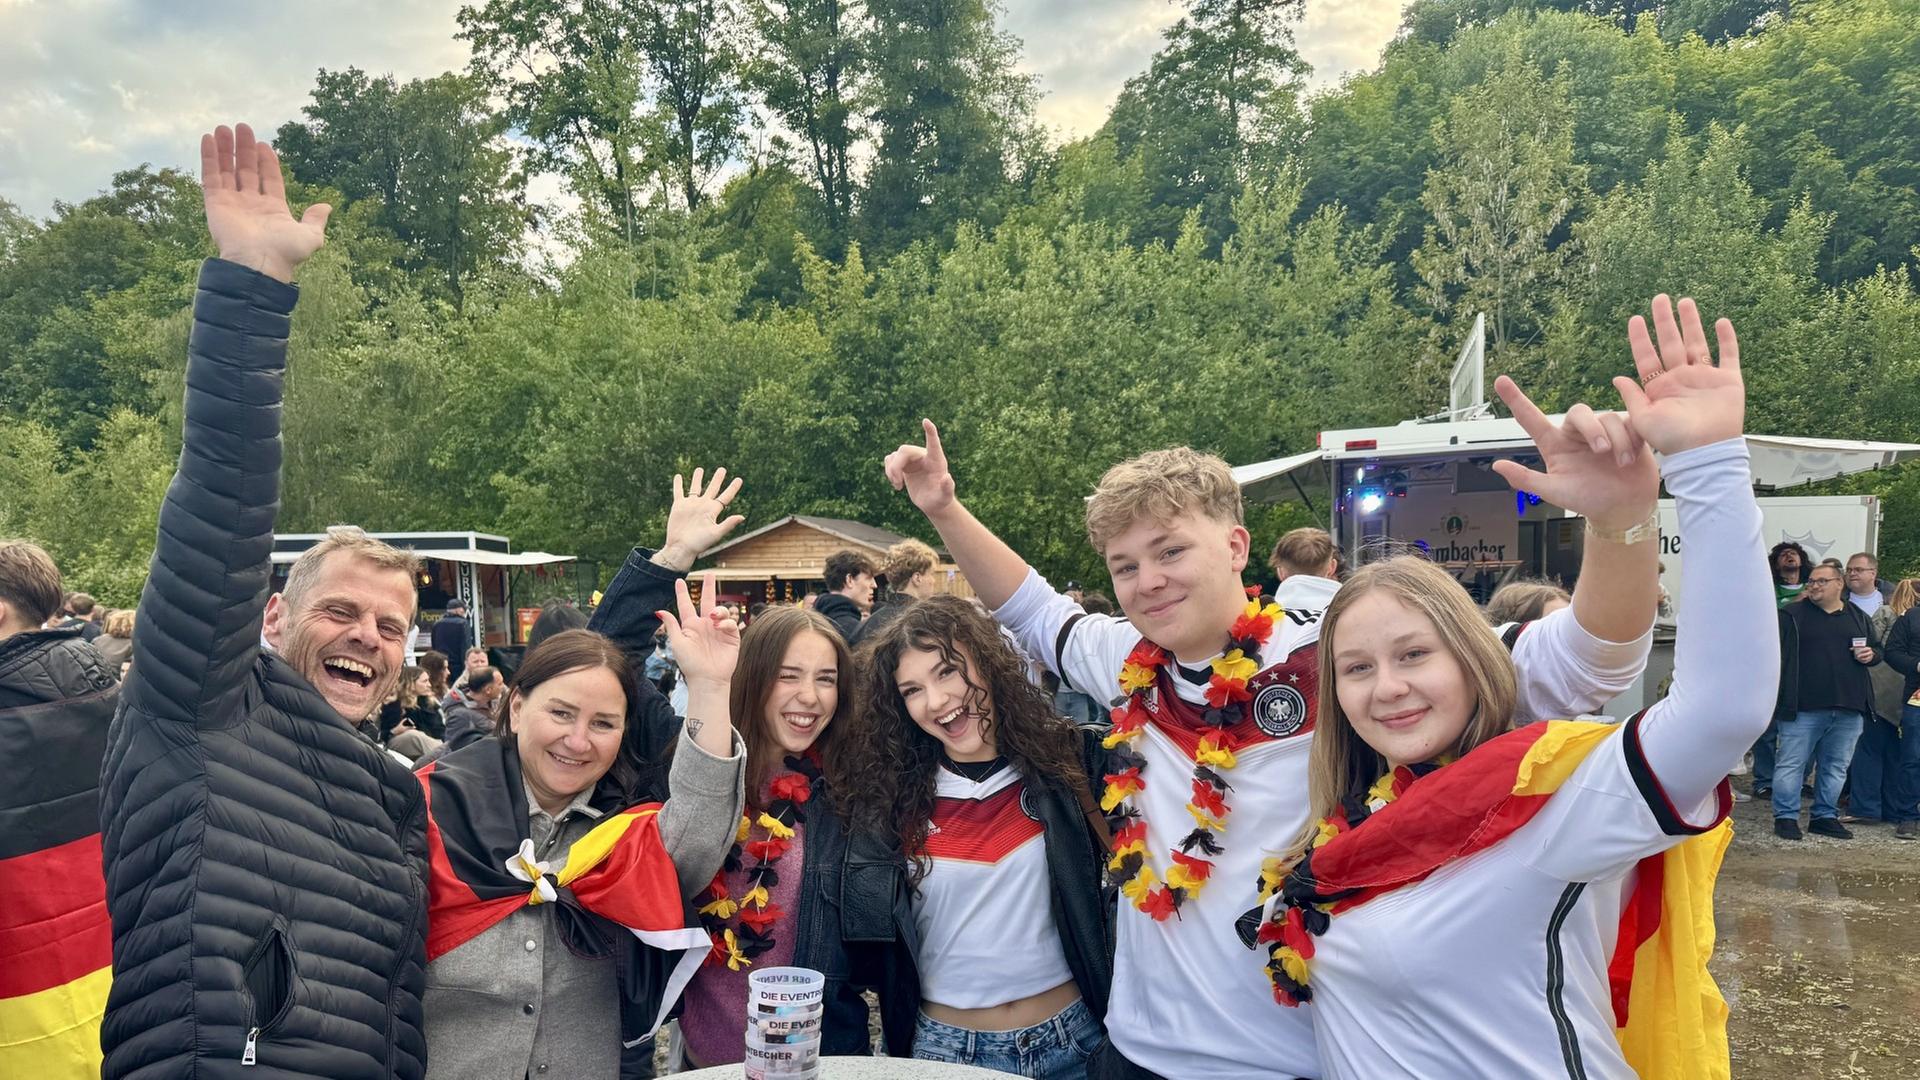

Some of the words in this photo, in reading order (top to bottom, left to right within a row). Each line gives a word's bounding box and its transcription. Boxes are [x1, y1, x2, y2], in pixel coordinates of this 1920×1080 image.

[1658, 527, 1681, 554] he
[761, 991, 778, 1001] DIE
[769, 1021, 789, 1029] DIE
